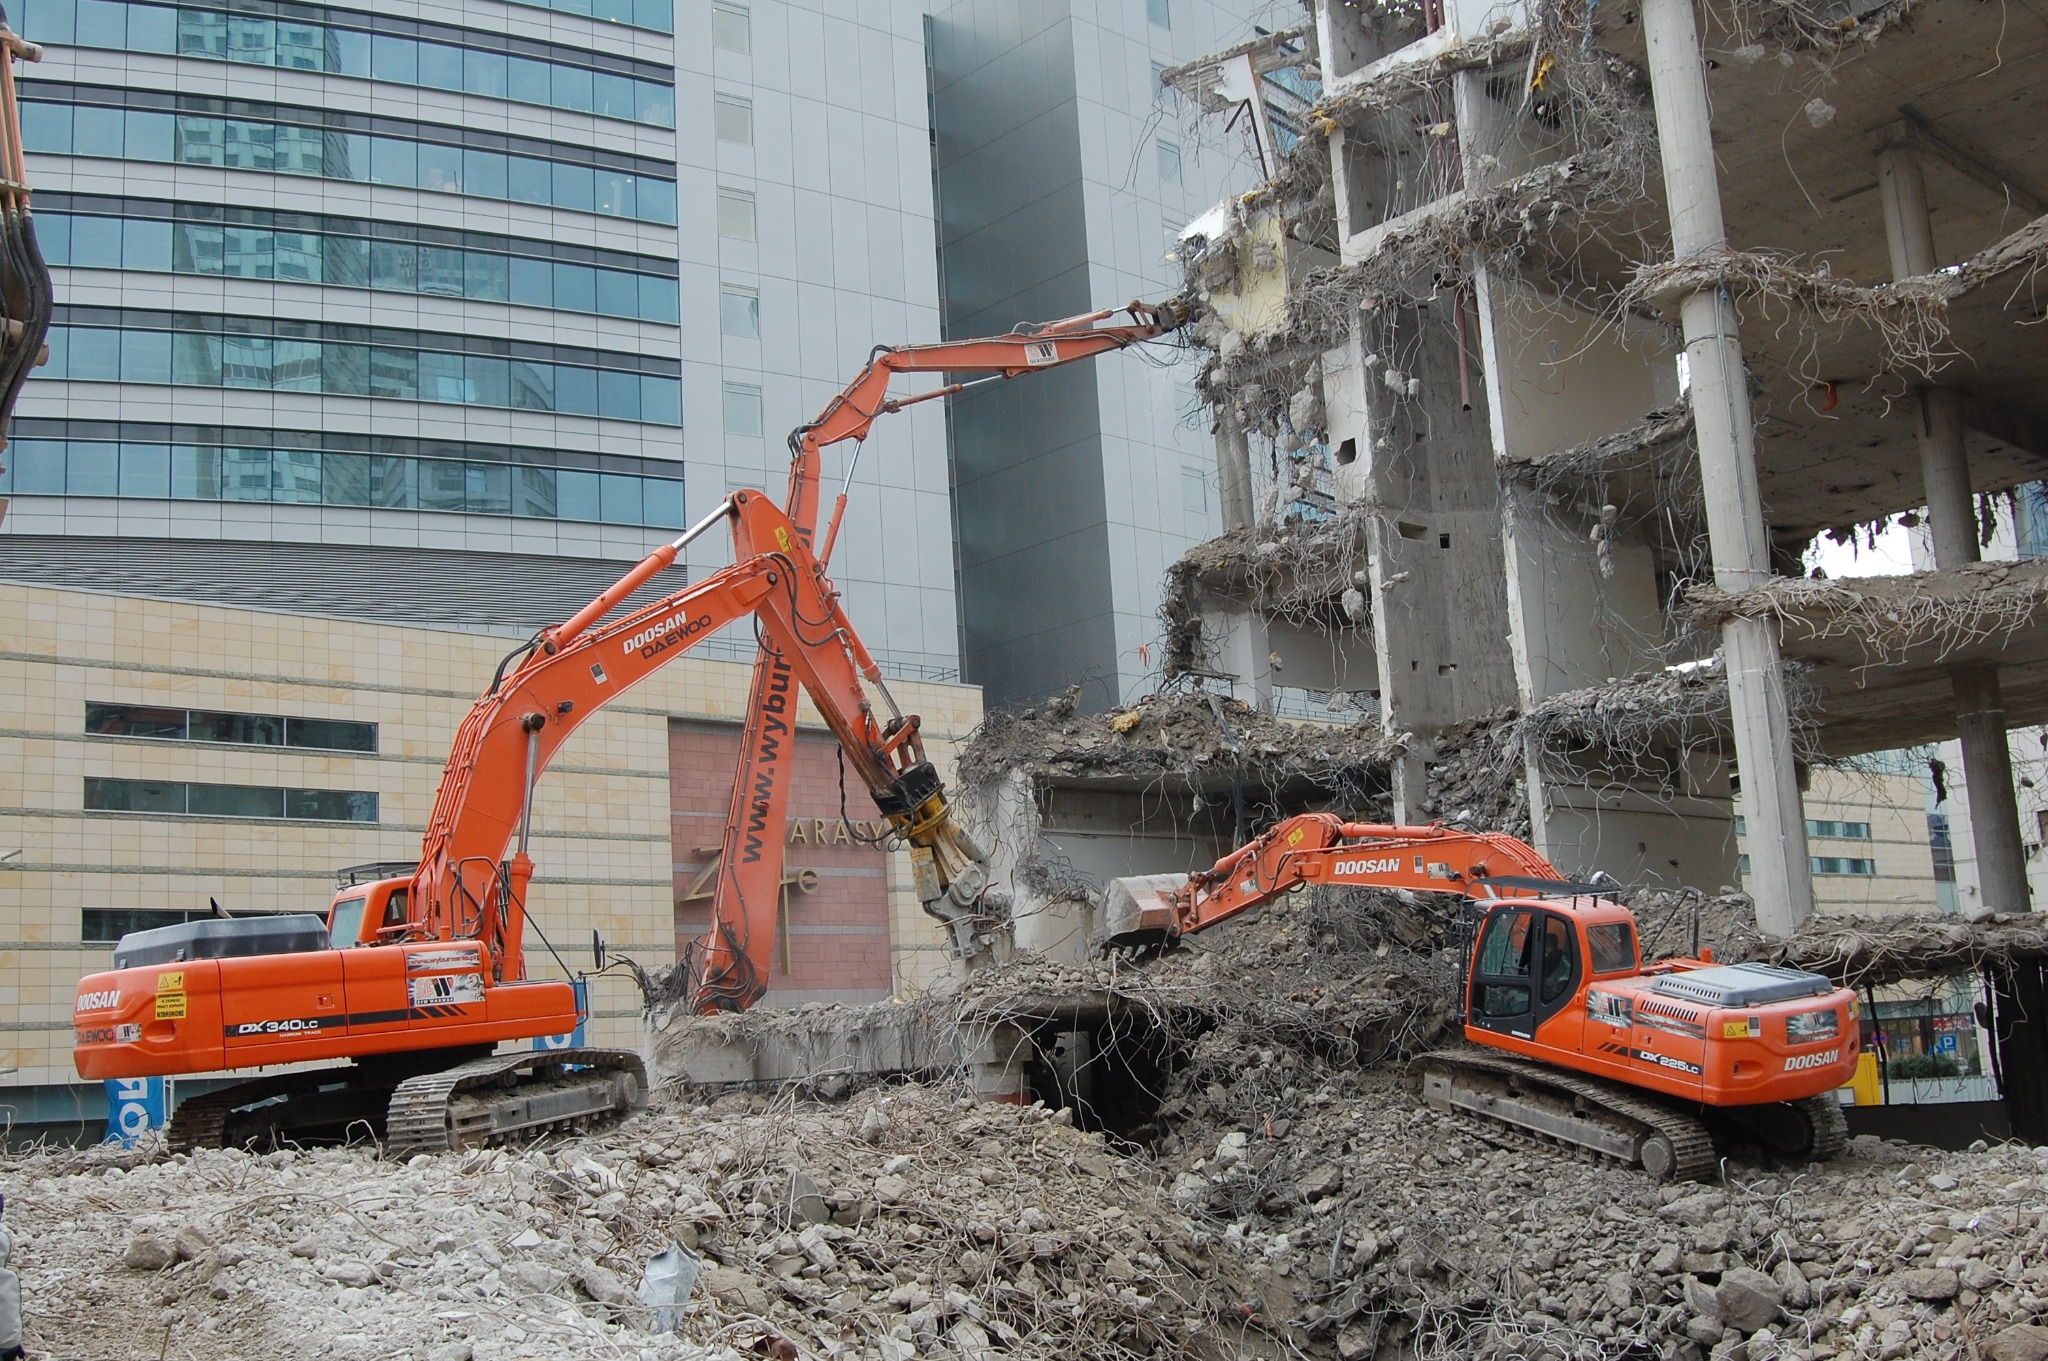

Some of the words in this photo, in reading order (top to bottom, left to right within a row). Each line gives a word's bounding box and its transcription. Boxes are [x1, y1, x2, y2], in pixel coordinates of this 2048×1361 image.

[623, 610, 687, 655] DOOSAN
[641, 614, 712, 660] DAEWOO
[742, 646, 792, 864] www.wybur
[1334, 858, 1400, 875] DOOSAN
[76, 990, 121, 1012] DOOSAN
[1784, 1049, 1839, 1071] DOOSAN
